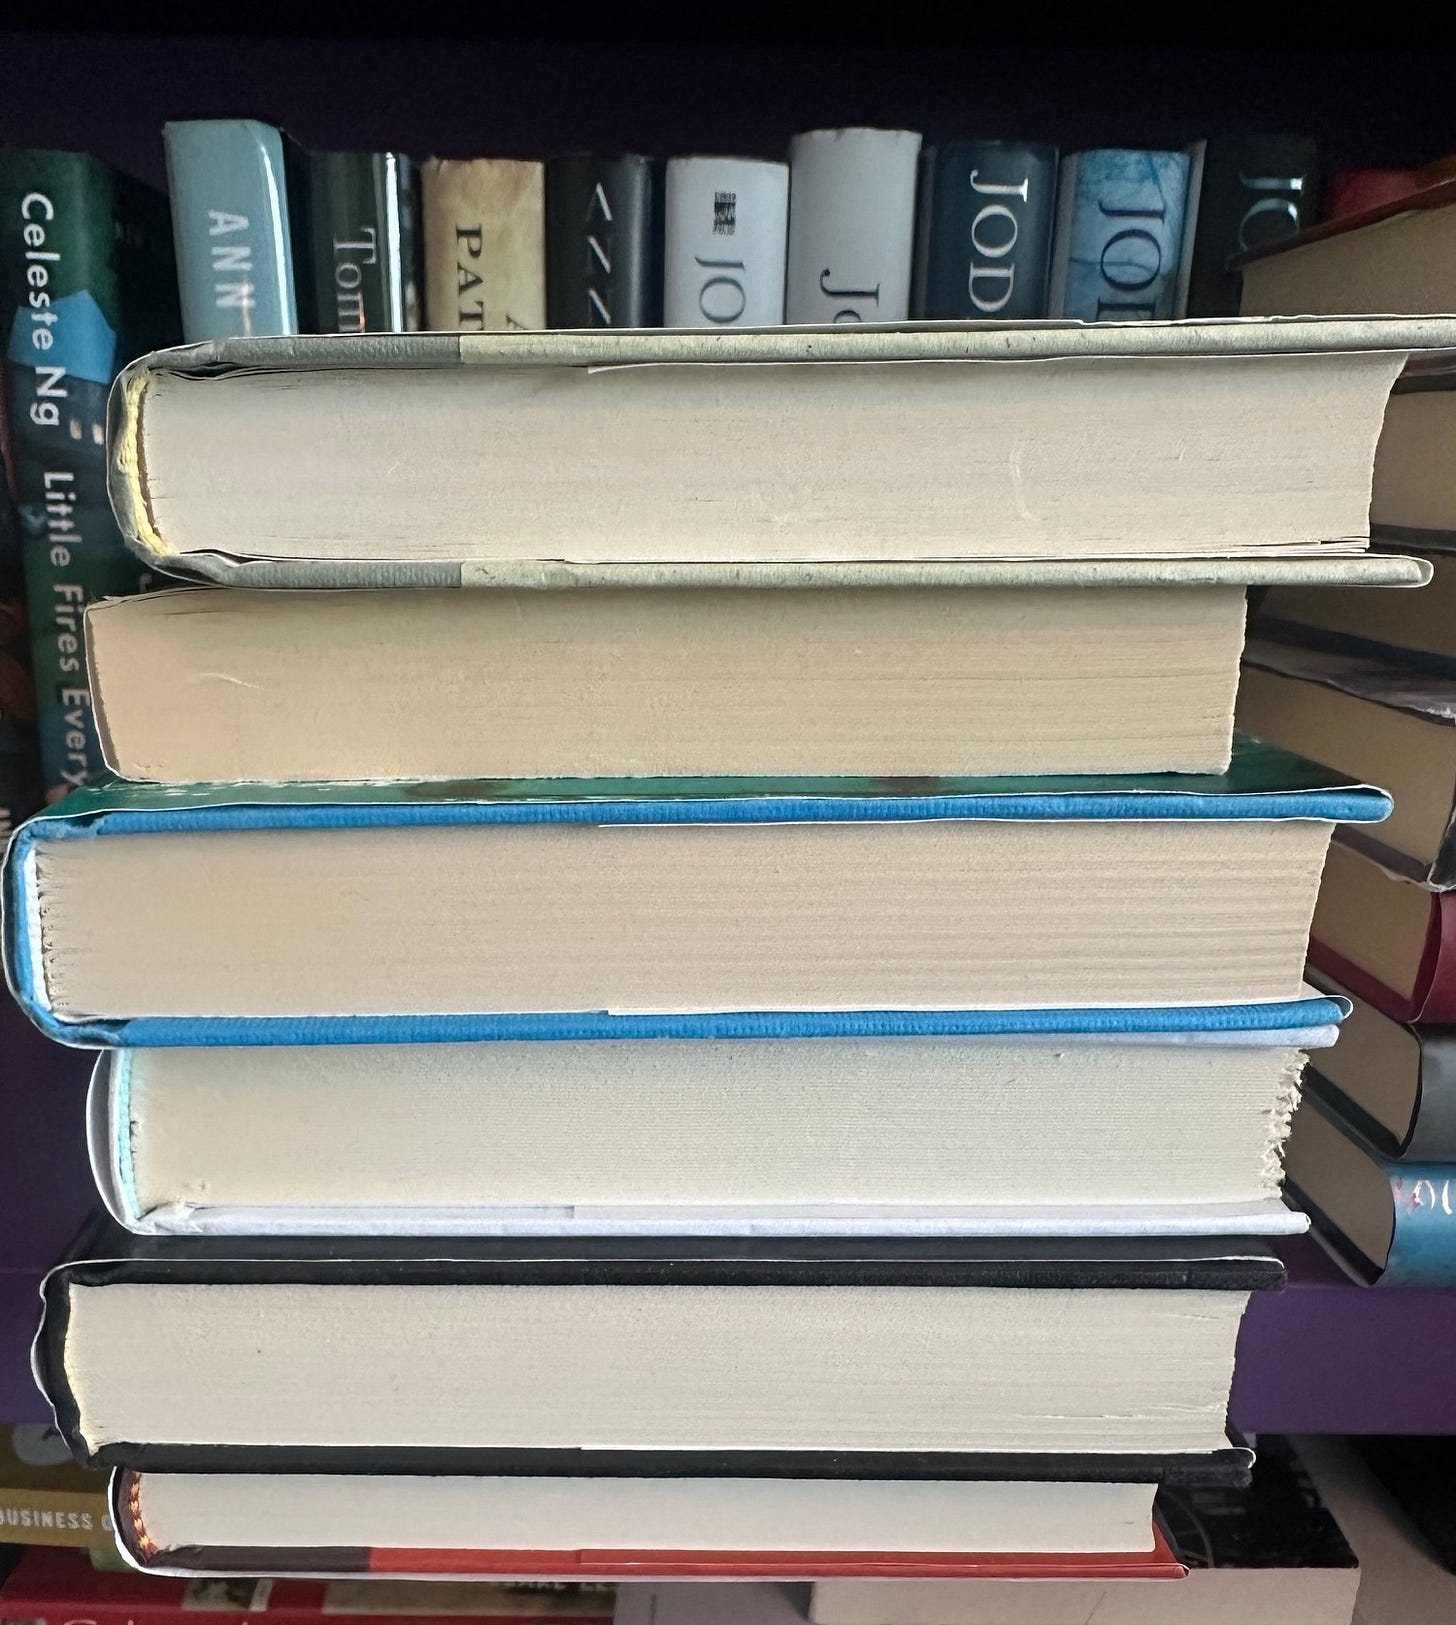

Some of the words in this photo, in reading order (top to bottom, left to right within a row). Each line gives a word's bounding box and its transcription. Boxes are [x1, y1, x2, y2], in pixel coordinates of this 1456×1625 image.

[21, 192, 60, 350] Celeste
[208, 210, 256, 307] ANN
[333, 225, 377, 332] Tom
[456, 223, 484, 330] PAT
[694, 255, 746, 323] JO
[968, 169, 1028, 312] JOD
[30, 366, 68, 426] Ng
[44, 472, 82, 567] Little
[53, 585, 83, 671] Fires
[60, 689, 91, 786] Every
